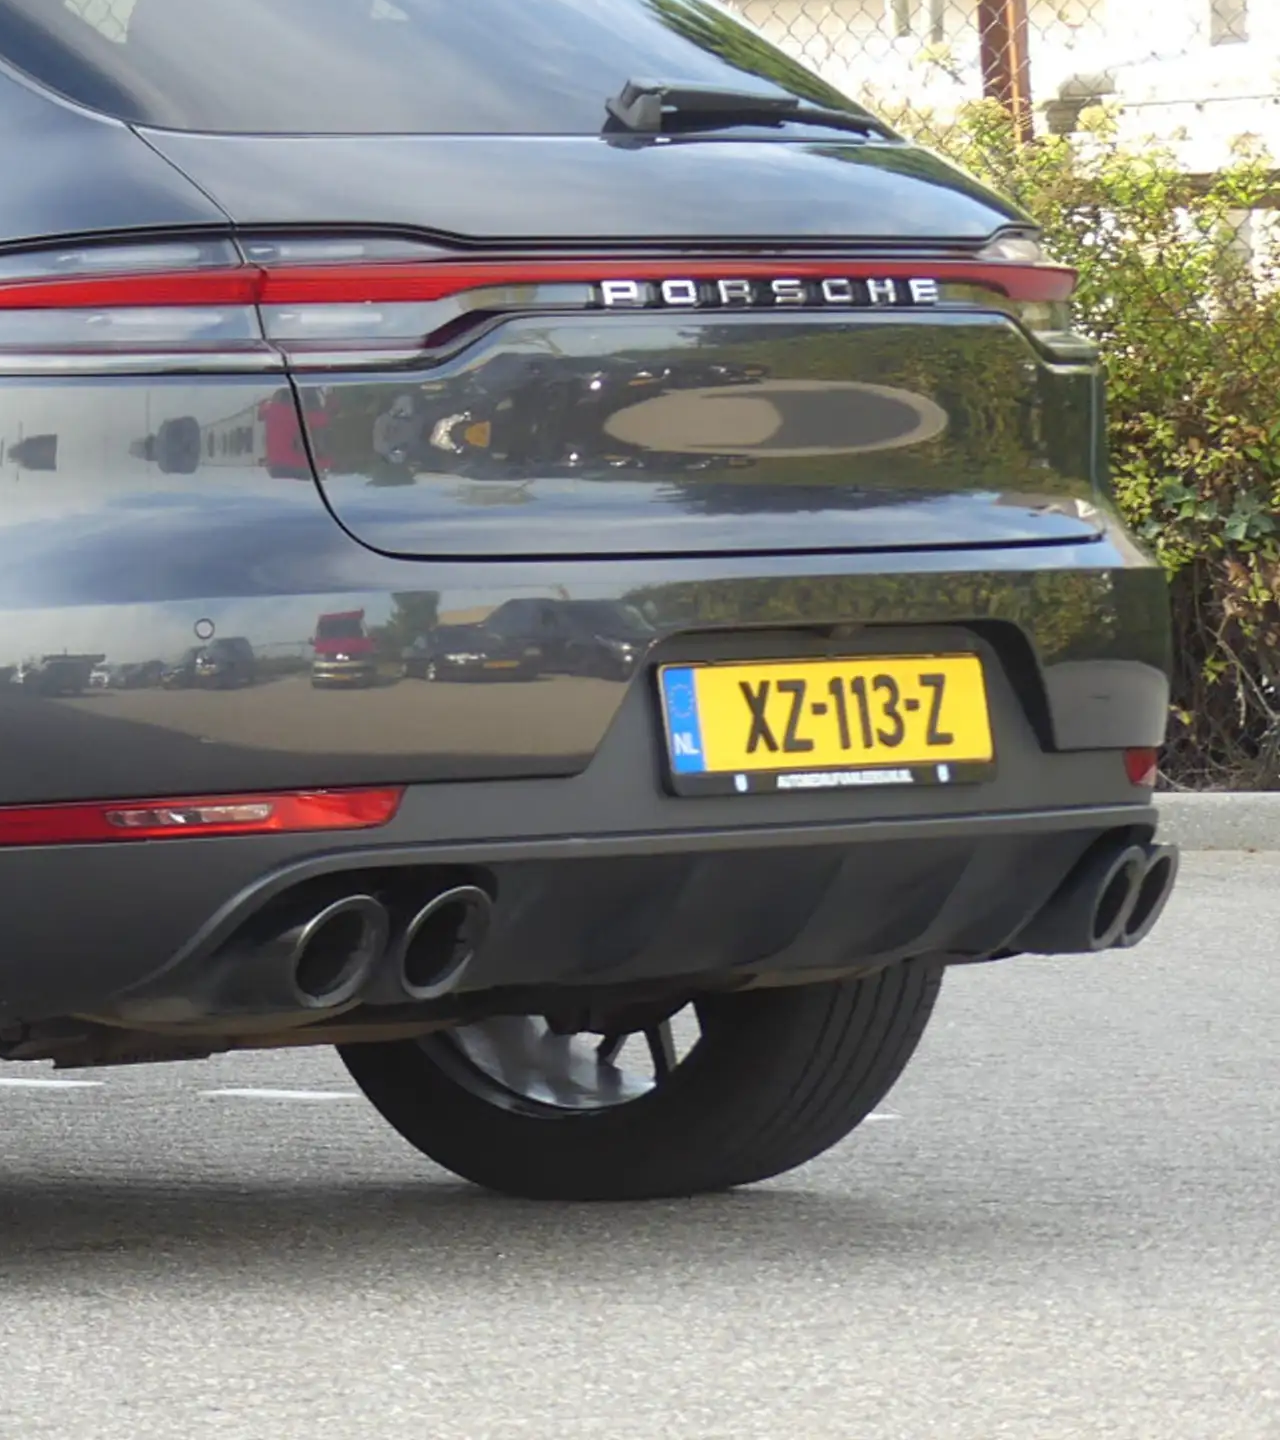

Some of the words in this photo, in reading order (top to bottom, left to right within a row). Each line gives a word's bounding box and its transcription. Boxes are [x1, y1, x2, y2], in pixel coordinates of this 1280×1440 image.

[601, 277, 939, 306] PORSCHE
[738, 673, 953, 753] XZ-113-Z
[674, 732, 699, 755] NL
